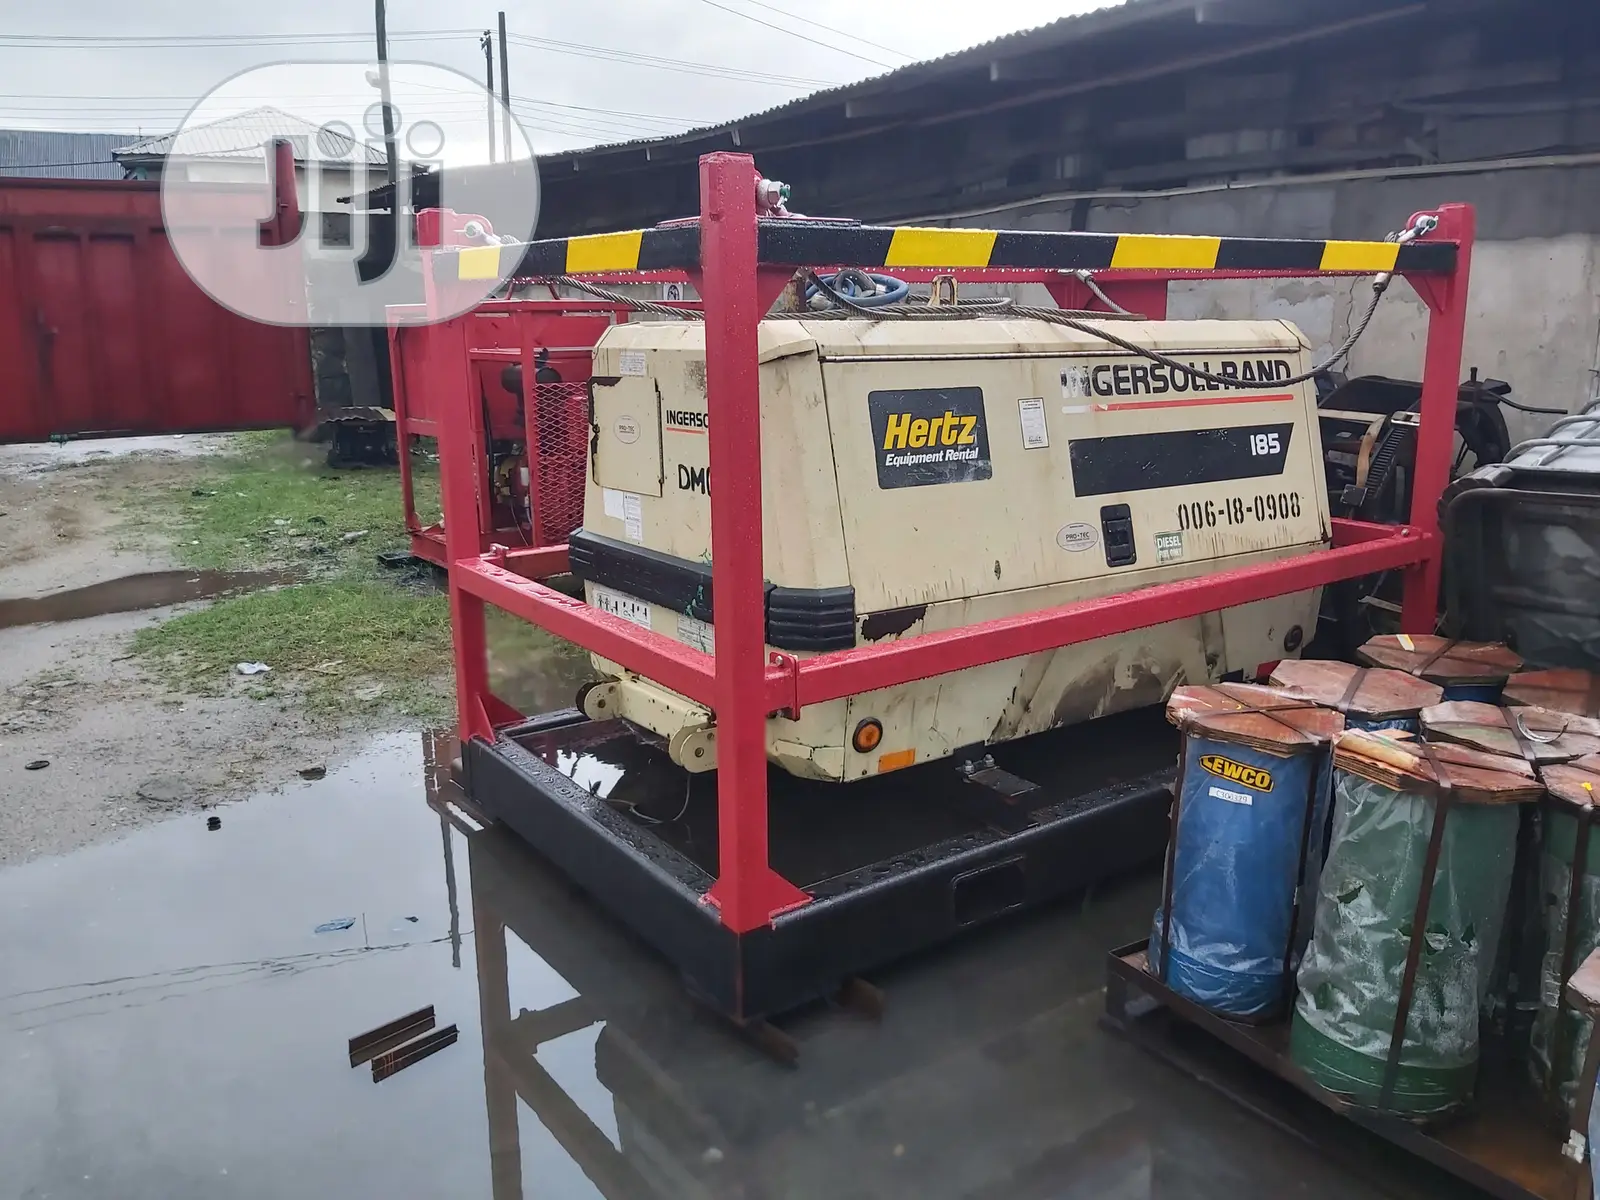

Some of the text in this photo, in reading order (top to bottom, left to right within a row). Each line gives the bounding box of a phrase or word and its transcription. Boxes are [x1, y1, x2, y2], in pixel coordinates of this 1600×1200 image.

[883, 411, 977, 450] Hertz
[1249, 432, 1281, 456] 185
[885, 447, 979, 467] Equipment Rental
[1177, 492, 1301, 530] 006-18-0908
[1157, 535, 1182, 549] DIESEL
[1202, 757, 1271, 788] LEWCO
